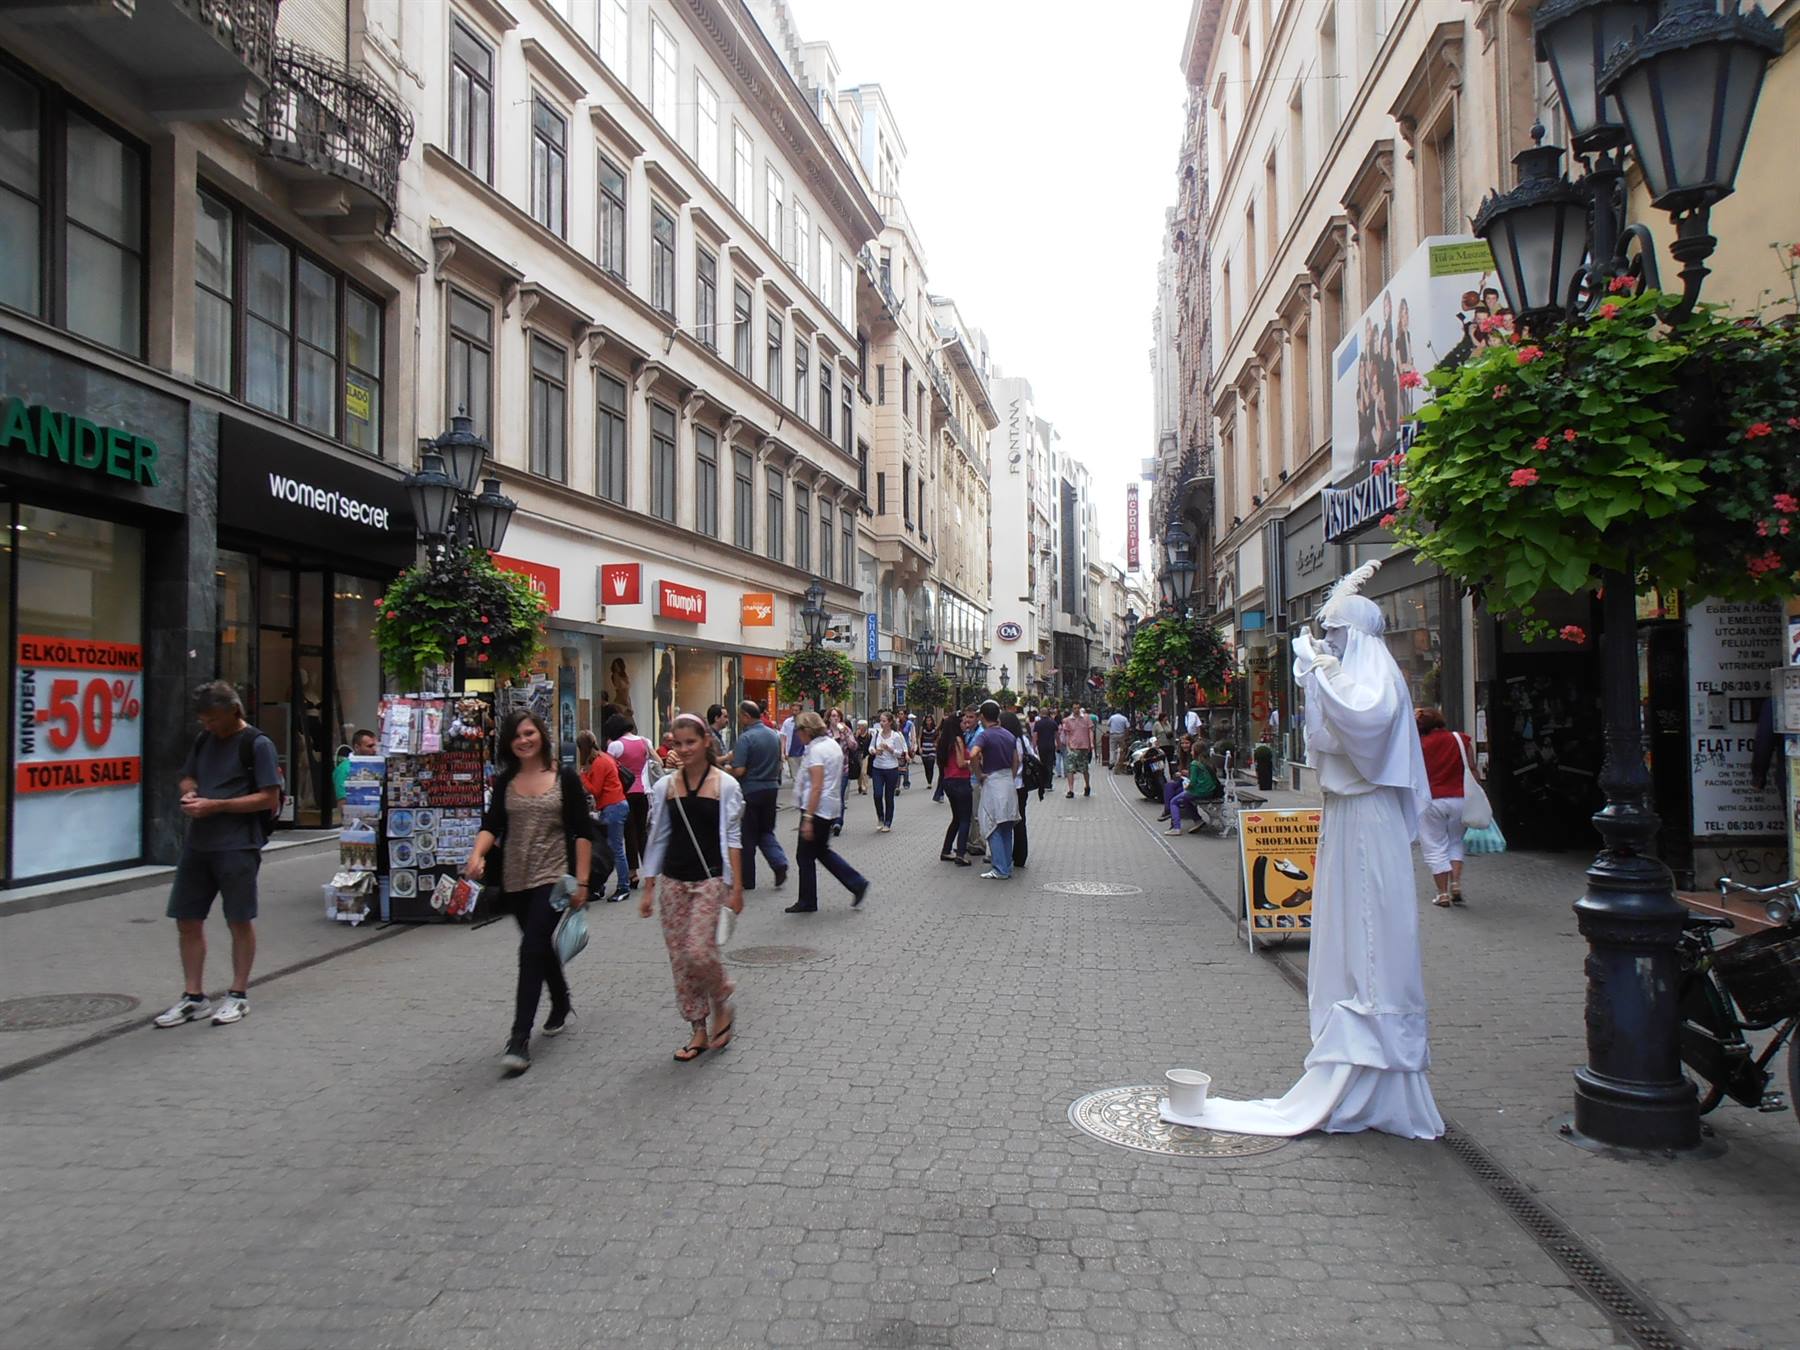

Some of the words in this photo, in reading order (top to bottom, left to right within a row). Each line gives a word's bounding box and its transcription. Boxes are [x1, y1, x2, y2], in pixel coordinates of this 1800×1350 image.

[0, 396, 161, 487] ANDER
[1008, 399, 1021, 474] FONTANA
[268, 472, 390, 531] women'secret
[664, 588, 697, 615] Triumph
[21, 643, 140, 667] ELKÖLTÖZÜNK
[868, 614, 877, 661] CHANGE
[21, 669, 36, 755] MINDEN
[36, 677, 140, 751] -50%
[1698, 738, 1733, 753] FLAT
[1738, 738, 1755, 753] FO
[27, 765, 84, 788] TOTAL
[90, 760, 132, 783] SALE
[1246, 824, 1320, 834] SCHUHMACHE
[1704, 821, 1724, 831] TEL:
